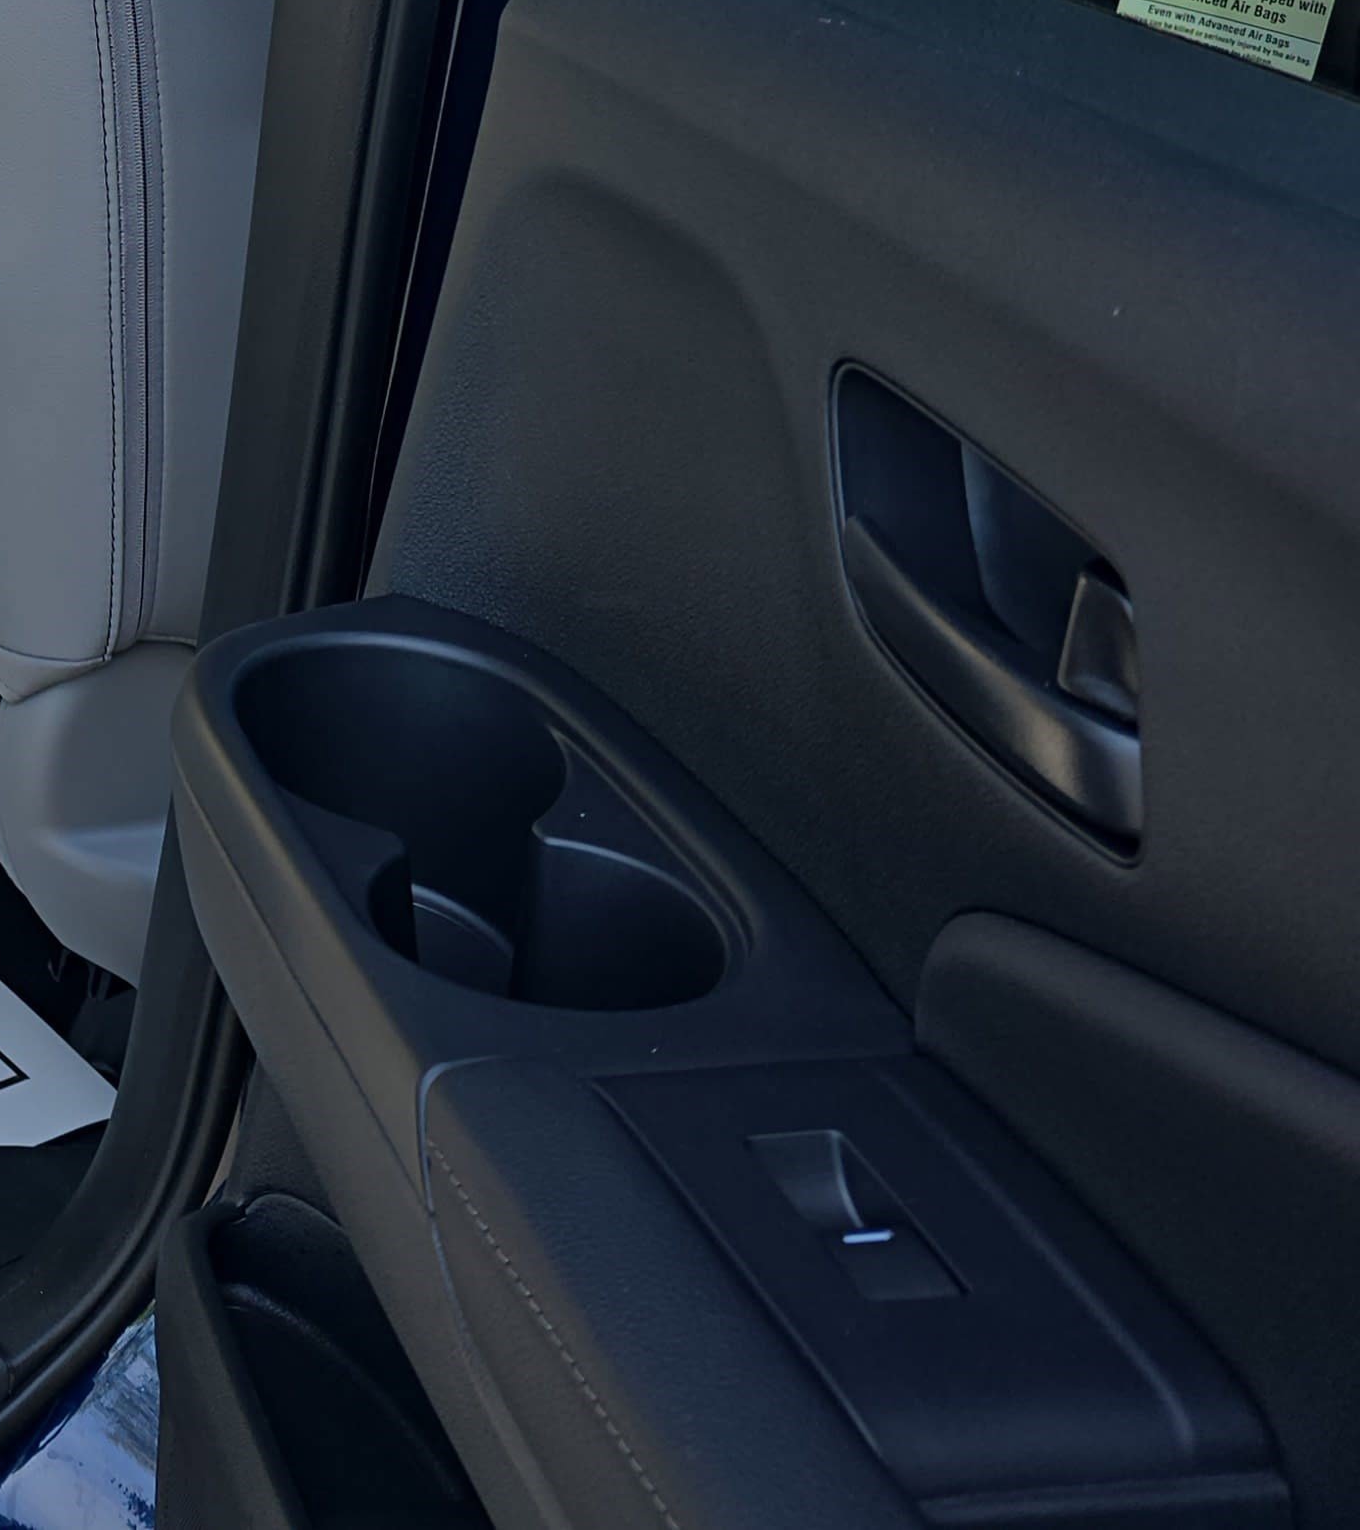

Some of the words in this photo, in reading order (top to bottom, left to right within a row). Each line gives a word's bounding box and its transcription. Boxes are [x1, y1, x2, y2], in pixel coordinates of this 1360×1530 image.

[1231, 0, 1252, 14] Air
[1254, 4, 1287, 24] Bags
[1299, 0, 1327, 16] with
[1147, 4, 1172, 19] Even
[1174, 11, 1196, 24] with
[1198, 16, 1247, 37] Advanced
[1247, 29, 1264, 41] Air
[1265, 33, 1290, 49] Bags
